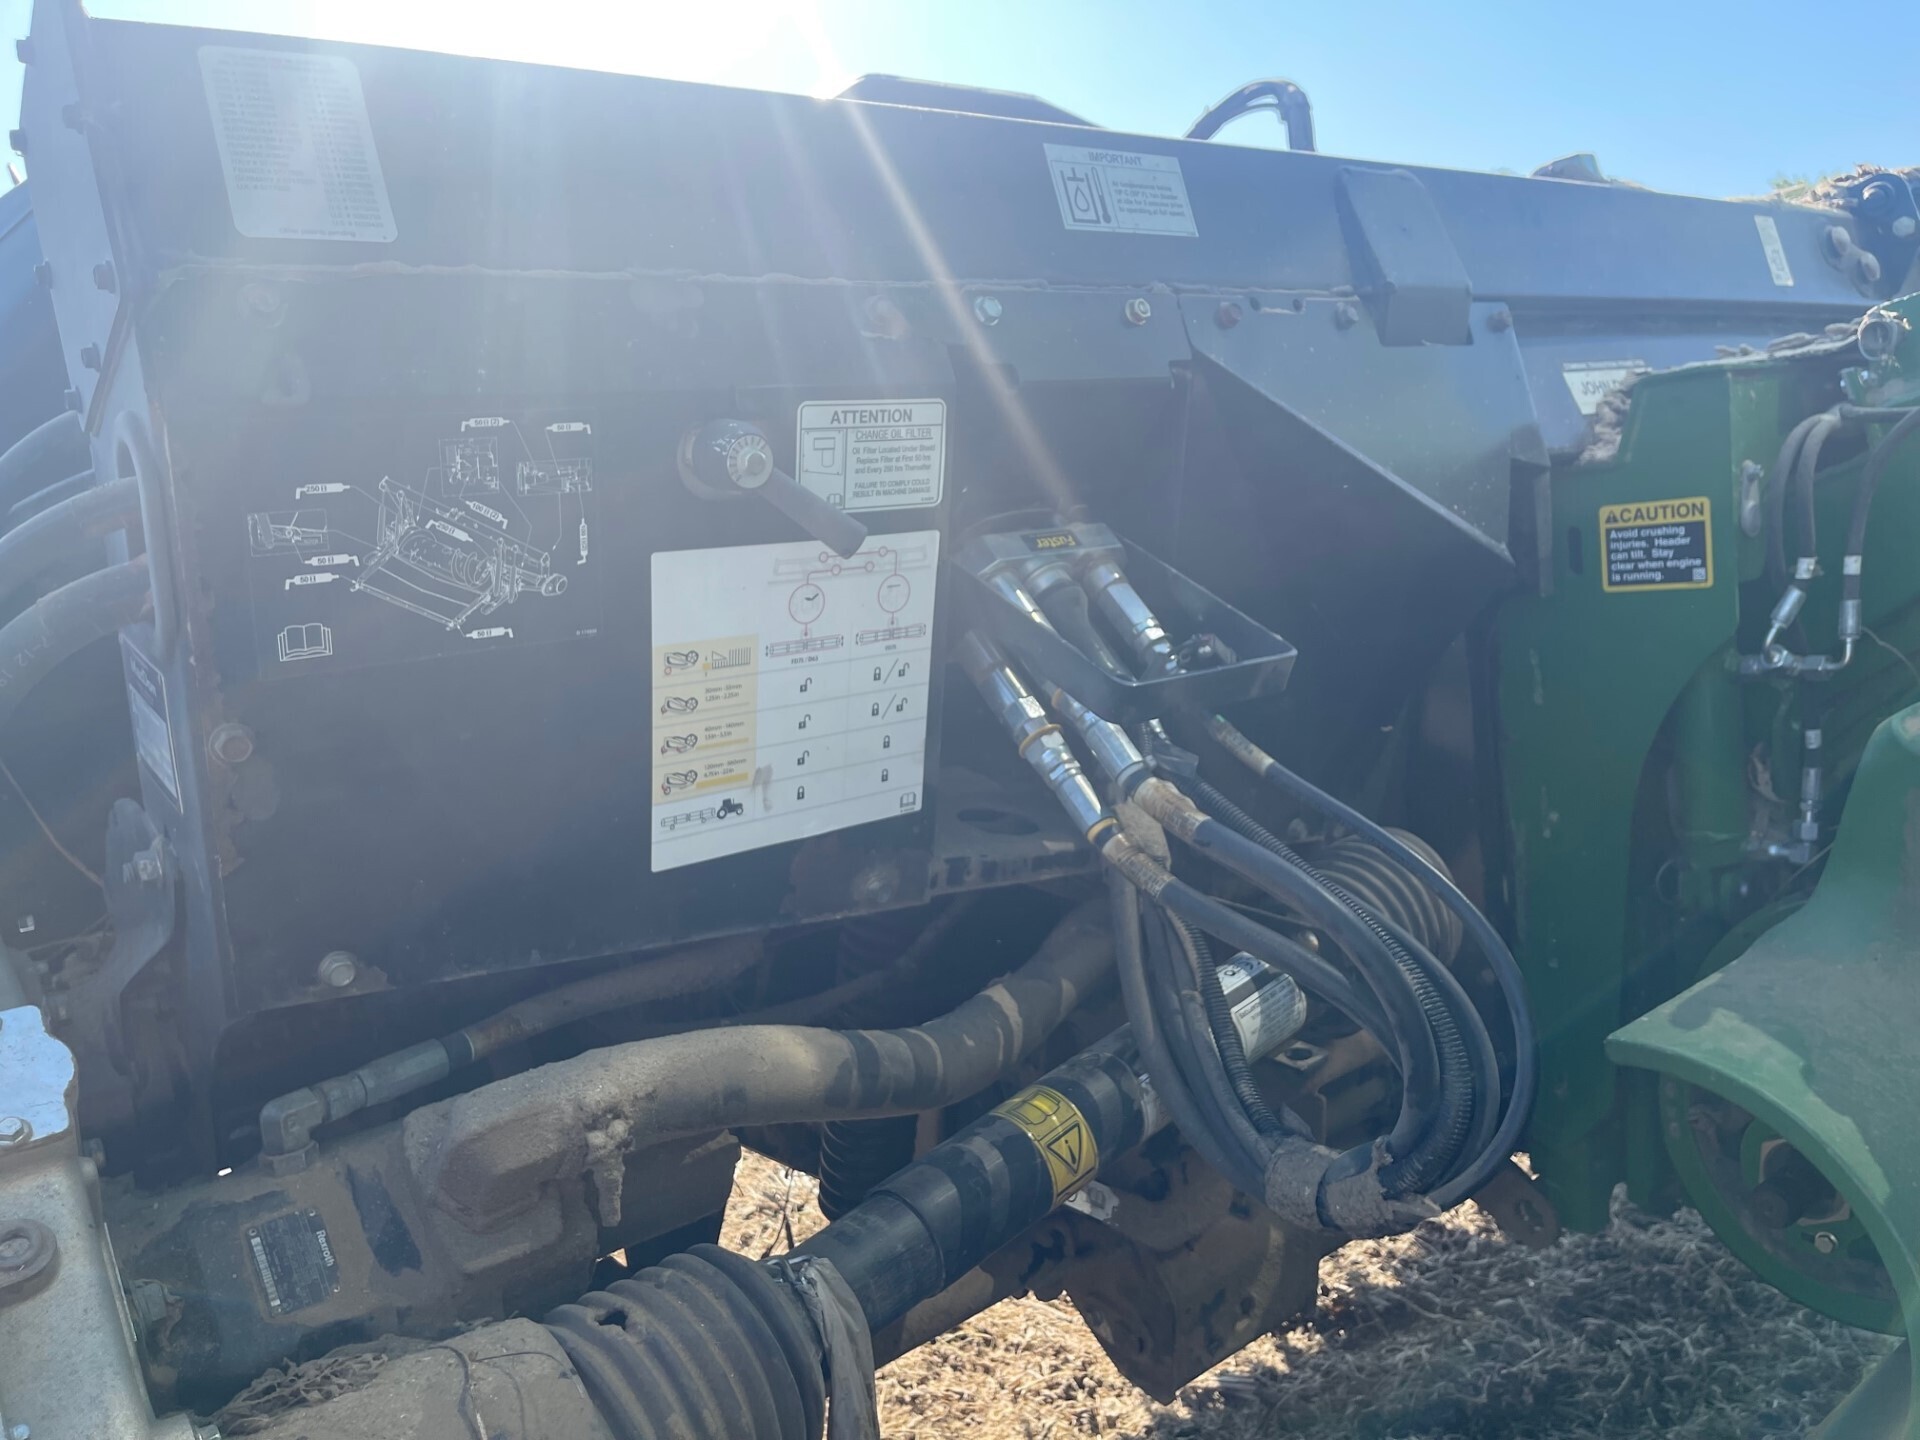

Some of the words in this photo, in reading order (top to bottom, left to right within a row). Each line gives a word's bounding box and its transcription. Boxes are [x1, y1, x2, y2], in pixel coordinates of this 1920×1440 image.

[1088, 152, 1143, 166] IMPORTANT
[830, 408, 913, 424] ATTENTION
[856, 430, 888, 440] CHANGE
[890, 429, 902, 439] OIL
[906, 428, 932, 438] FILTER
[878, 446, 900, 454] Located
[856, 456, 879, 464] Replace
[866, 466, 882, 475] Every
[888, 480, 910, 488] COMPLY
[882, 488, 907, 496] MACHINE
[908, 486, 930, 494] DAMAGE
[1620, 502, 1704, 524] CAUTION
[1610, 528, 1638, 539] Avoid
[1640, 526, 1686, 536] crushing
[1610, 540, 1649, 551] injuries.
[1654, 536, 1692, 547] Header
[1610, 552, 1628, 561] can
[1630, 550, 1646, 559] tilt.
[1651, 548, 1674, 559] Stay
[1611, 562, 1634, 571] clear
[1638, 560, 1664, 569] when
[1666, 558, 1702, 570] engine
[1612, 572, 1621, 582] is
[1623, 570, 1664, 582] running.
[316, 1230, 334, 1267] Rexroth
